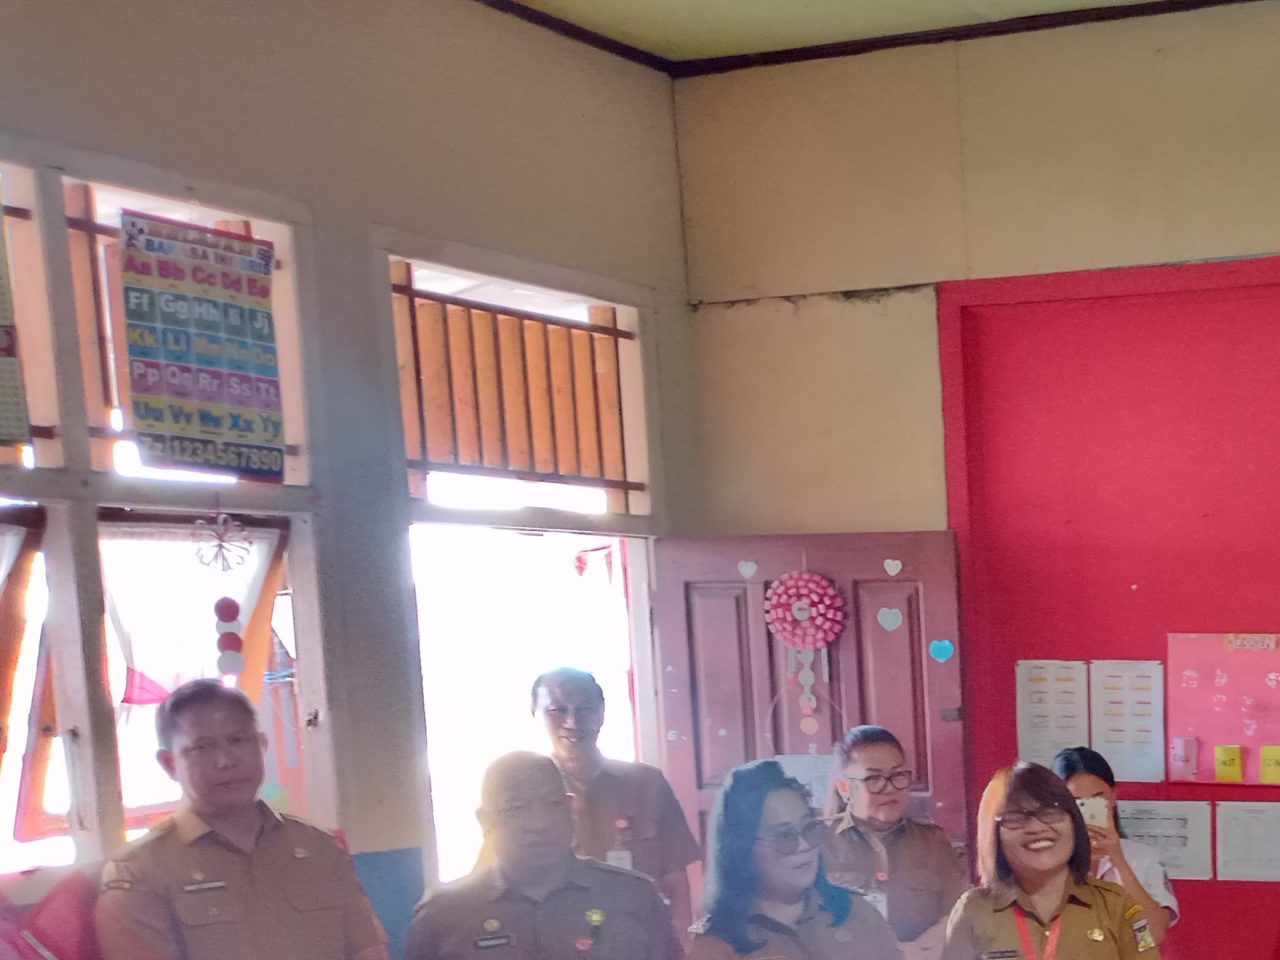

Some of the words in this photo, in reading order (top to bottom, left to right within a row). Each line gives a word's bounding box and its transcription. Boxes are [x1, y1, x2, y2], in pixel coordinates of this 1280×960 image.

[192, 265, 217, 287] Cc
[221, 272, 242, 293] Dd
[128, 291, 150, 311] Ff
[161, 294, 190, 319] Gg
[193, 300, 220, 322] Hh
[254, 311, 270, 334] Jj
[133, 362, 160, 385] Pp
[199, 373, 220, 392] Rr
[229, 378, 251, 396] Ss
[256, 382, 278, 400] Tt
[134, 401, 164, 422] Uu
[168, 405, 193, 425] Vv
[229, 412, 254, 433] Xx
[258, 414, 282, 438] Yy
